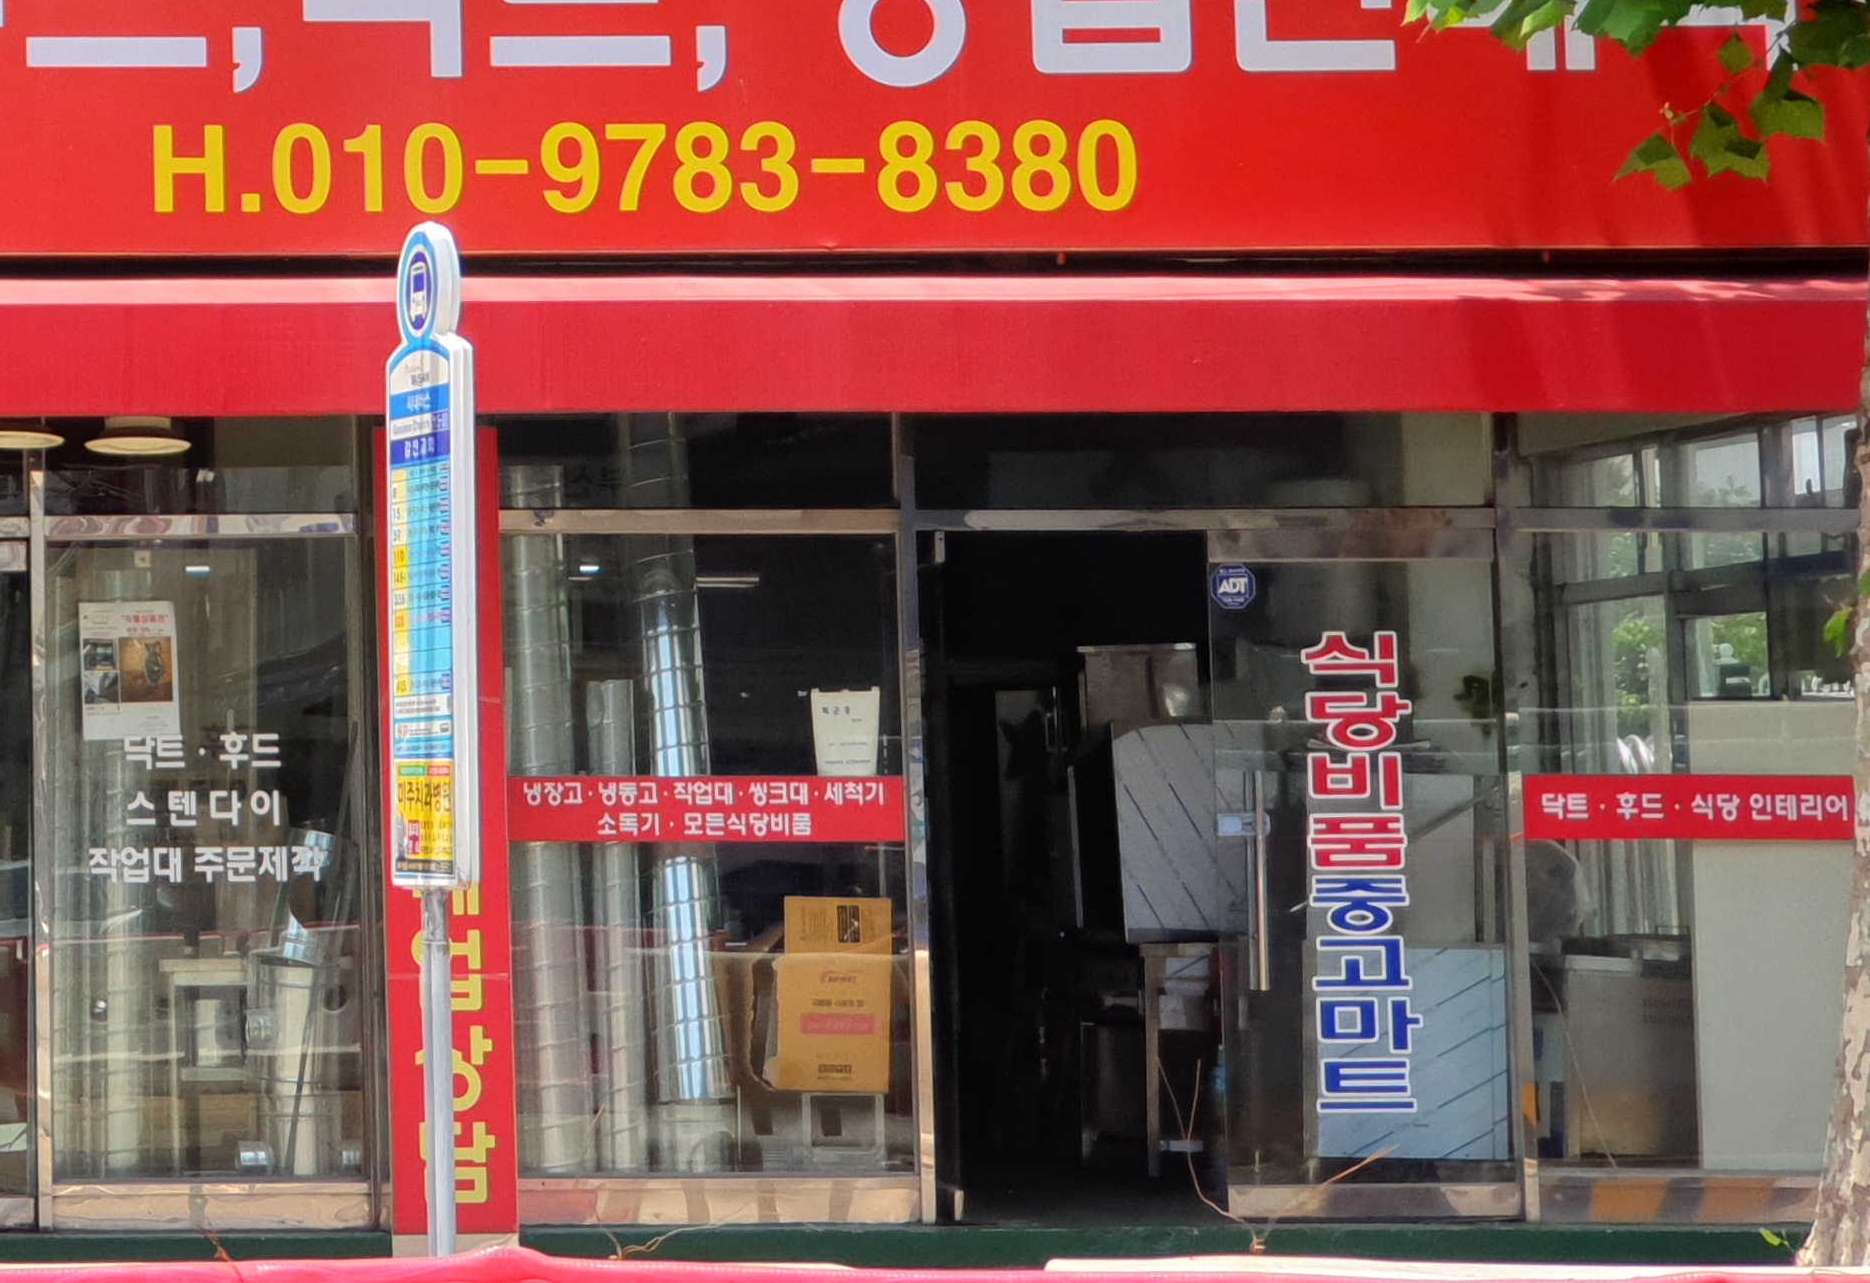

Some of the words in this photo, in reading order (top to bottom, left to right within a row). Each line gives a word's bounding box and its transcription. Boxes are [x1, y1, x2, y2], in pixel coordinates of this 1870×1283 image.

[152, 119, 1138, 215] H.010-9783-8380
[1217, 577, 1248, 594] ADT
[123, 733, 186, 770] 닥트
[219, 731, 283, 770] 후드
[522, 781, 584, 807] 냉장고
[597, 781, 660, 807] 냉동고
[673, 781, 734, 807] 작업대
[748, 781, 809, 807] 씽크대
[823, 781, 886, 807] 세척기
[1541, 792, 1590, 820] 닥트
[1616, 791, 1665, 820] 후드
[1690, 793, 1740, 821] 식당
[1748, 793, 1849, 822] 인테리어
[596, 812, 661, 837] 소독기
[683, 812, 813, 837] 모든식당비품
[88, 846, 183, 884] 작업대
[194, 846, 323, 883] 주문제작
[1301, 631, 1423, 1113] 식당비품중고마트
